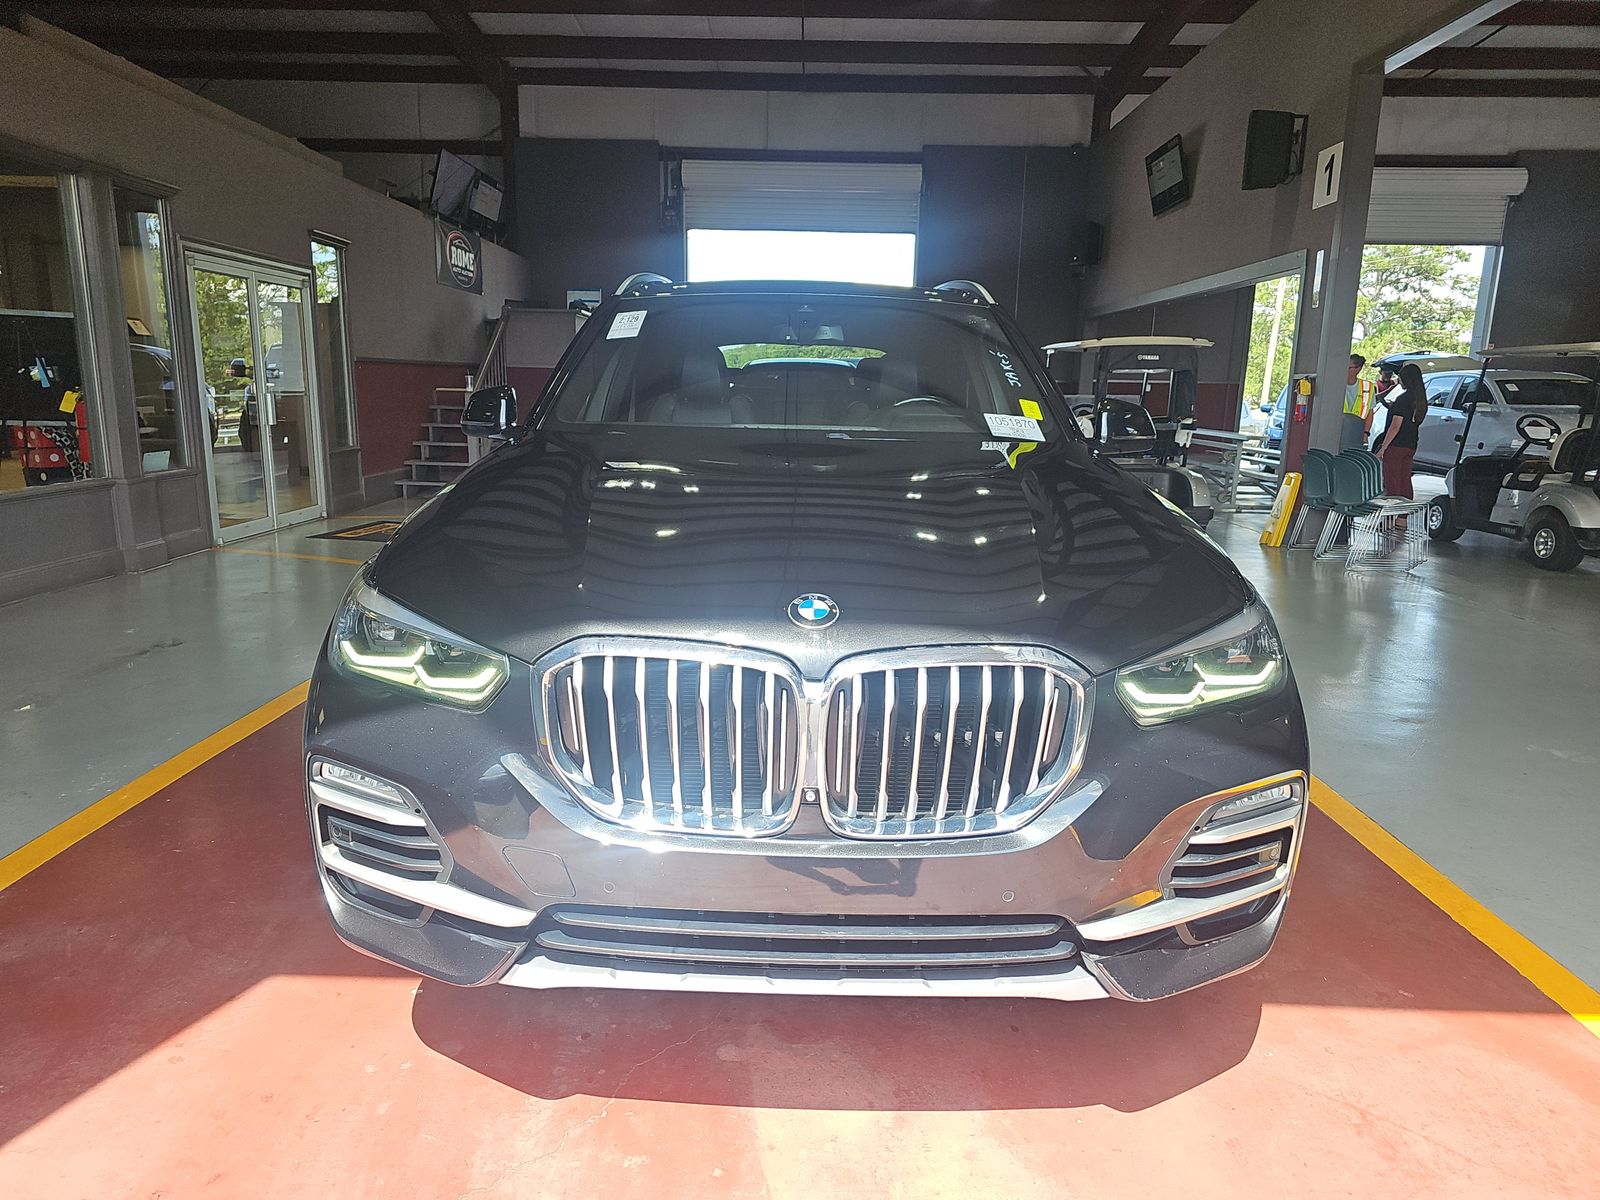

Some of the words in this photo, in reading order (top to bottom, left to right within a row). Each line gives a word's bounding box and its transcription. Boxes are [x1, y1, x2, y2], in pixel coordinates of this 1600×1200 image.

[1324, 153, 1336, 197] 1
[451, 246, 475, 271] ROME
[988, 416, 1036, 430] 1051870
[793, 594, 834, 606] BMW
